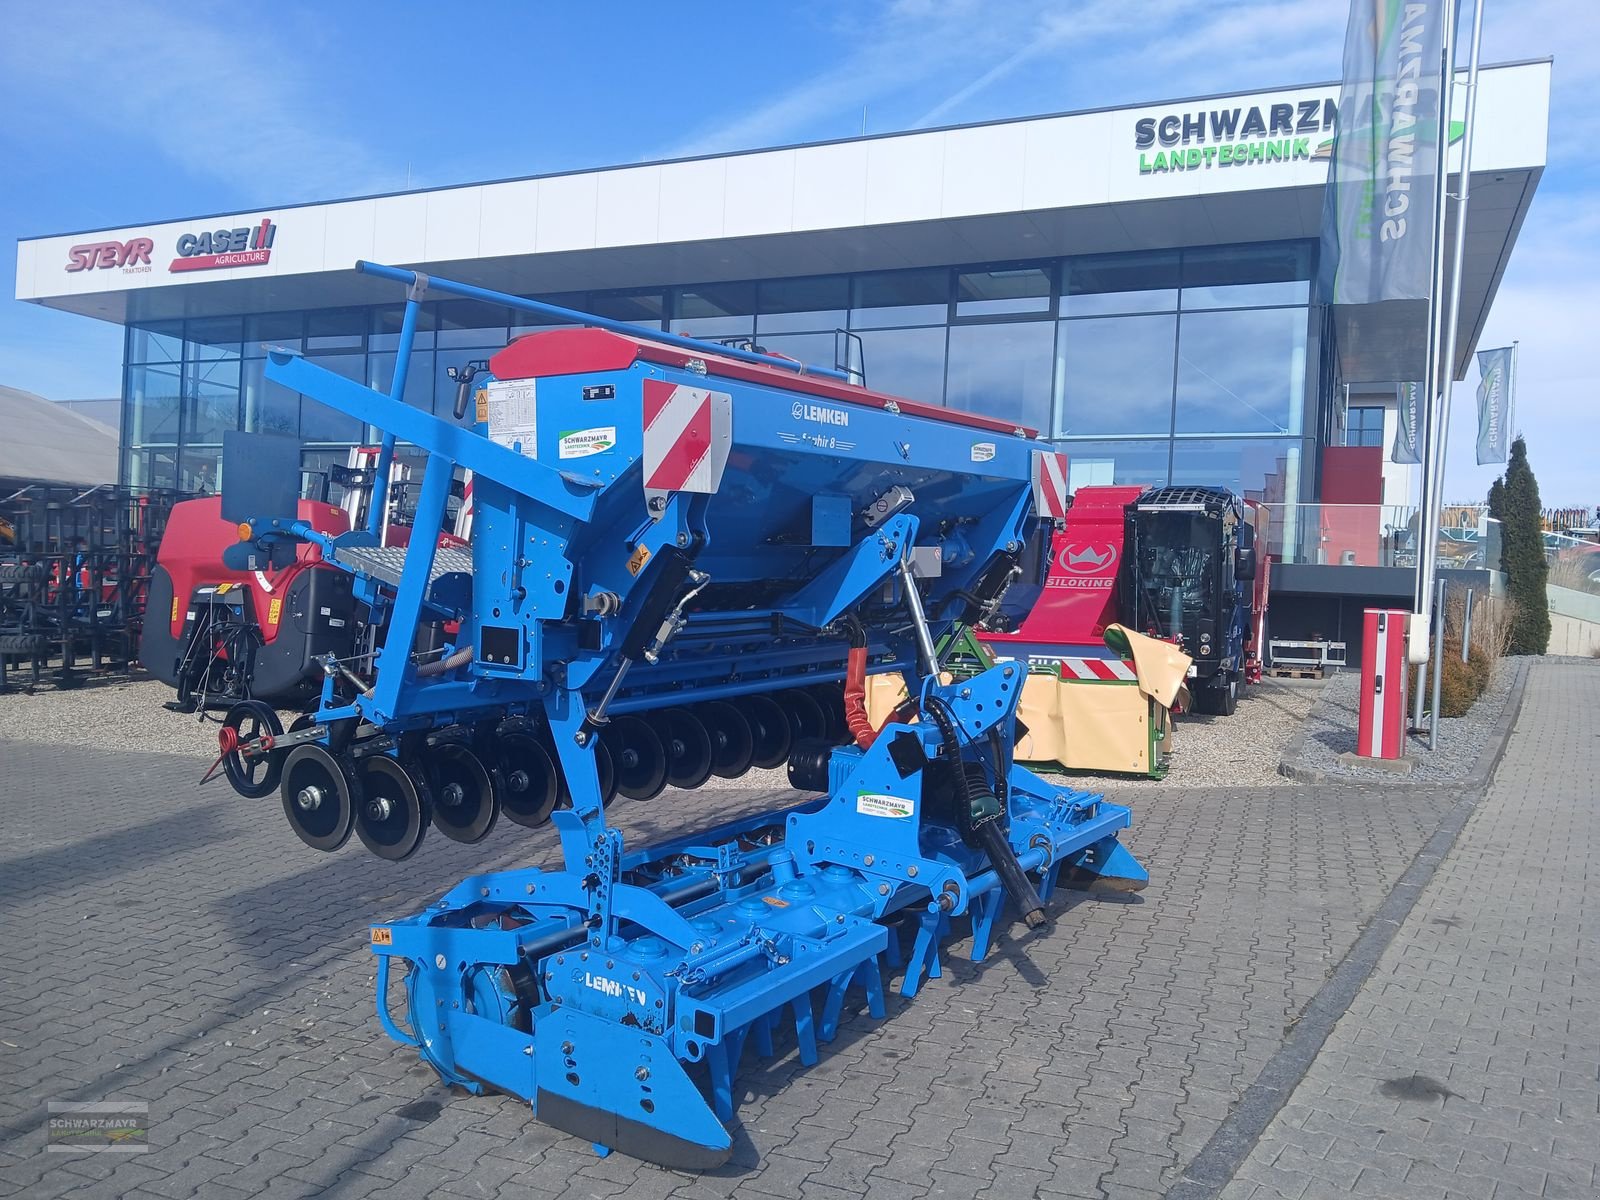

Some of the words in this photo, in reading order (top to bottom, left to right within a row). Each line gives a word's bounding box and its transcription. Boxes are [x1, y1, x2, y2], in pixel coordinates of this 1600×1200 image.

[1139, 137, 1309, 173] LANDTECHNIK
[176, 227, 250, 257] CASE
[65, 237, 154, 273] STEYR
[214, 251, 265, 265] AGRICULTURE
[122, 266, 152, 275] TRAKTOREN
[803, 404, 848, 427] LEMKEN
[564, 435, 608, 445] SCHWARZMAYR
[829, 436, 836, 449] 8
[1046, 578, 1114, 588] SILOKING
[862, 796, 906, 809] SCHWARZMAYR
